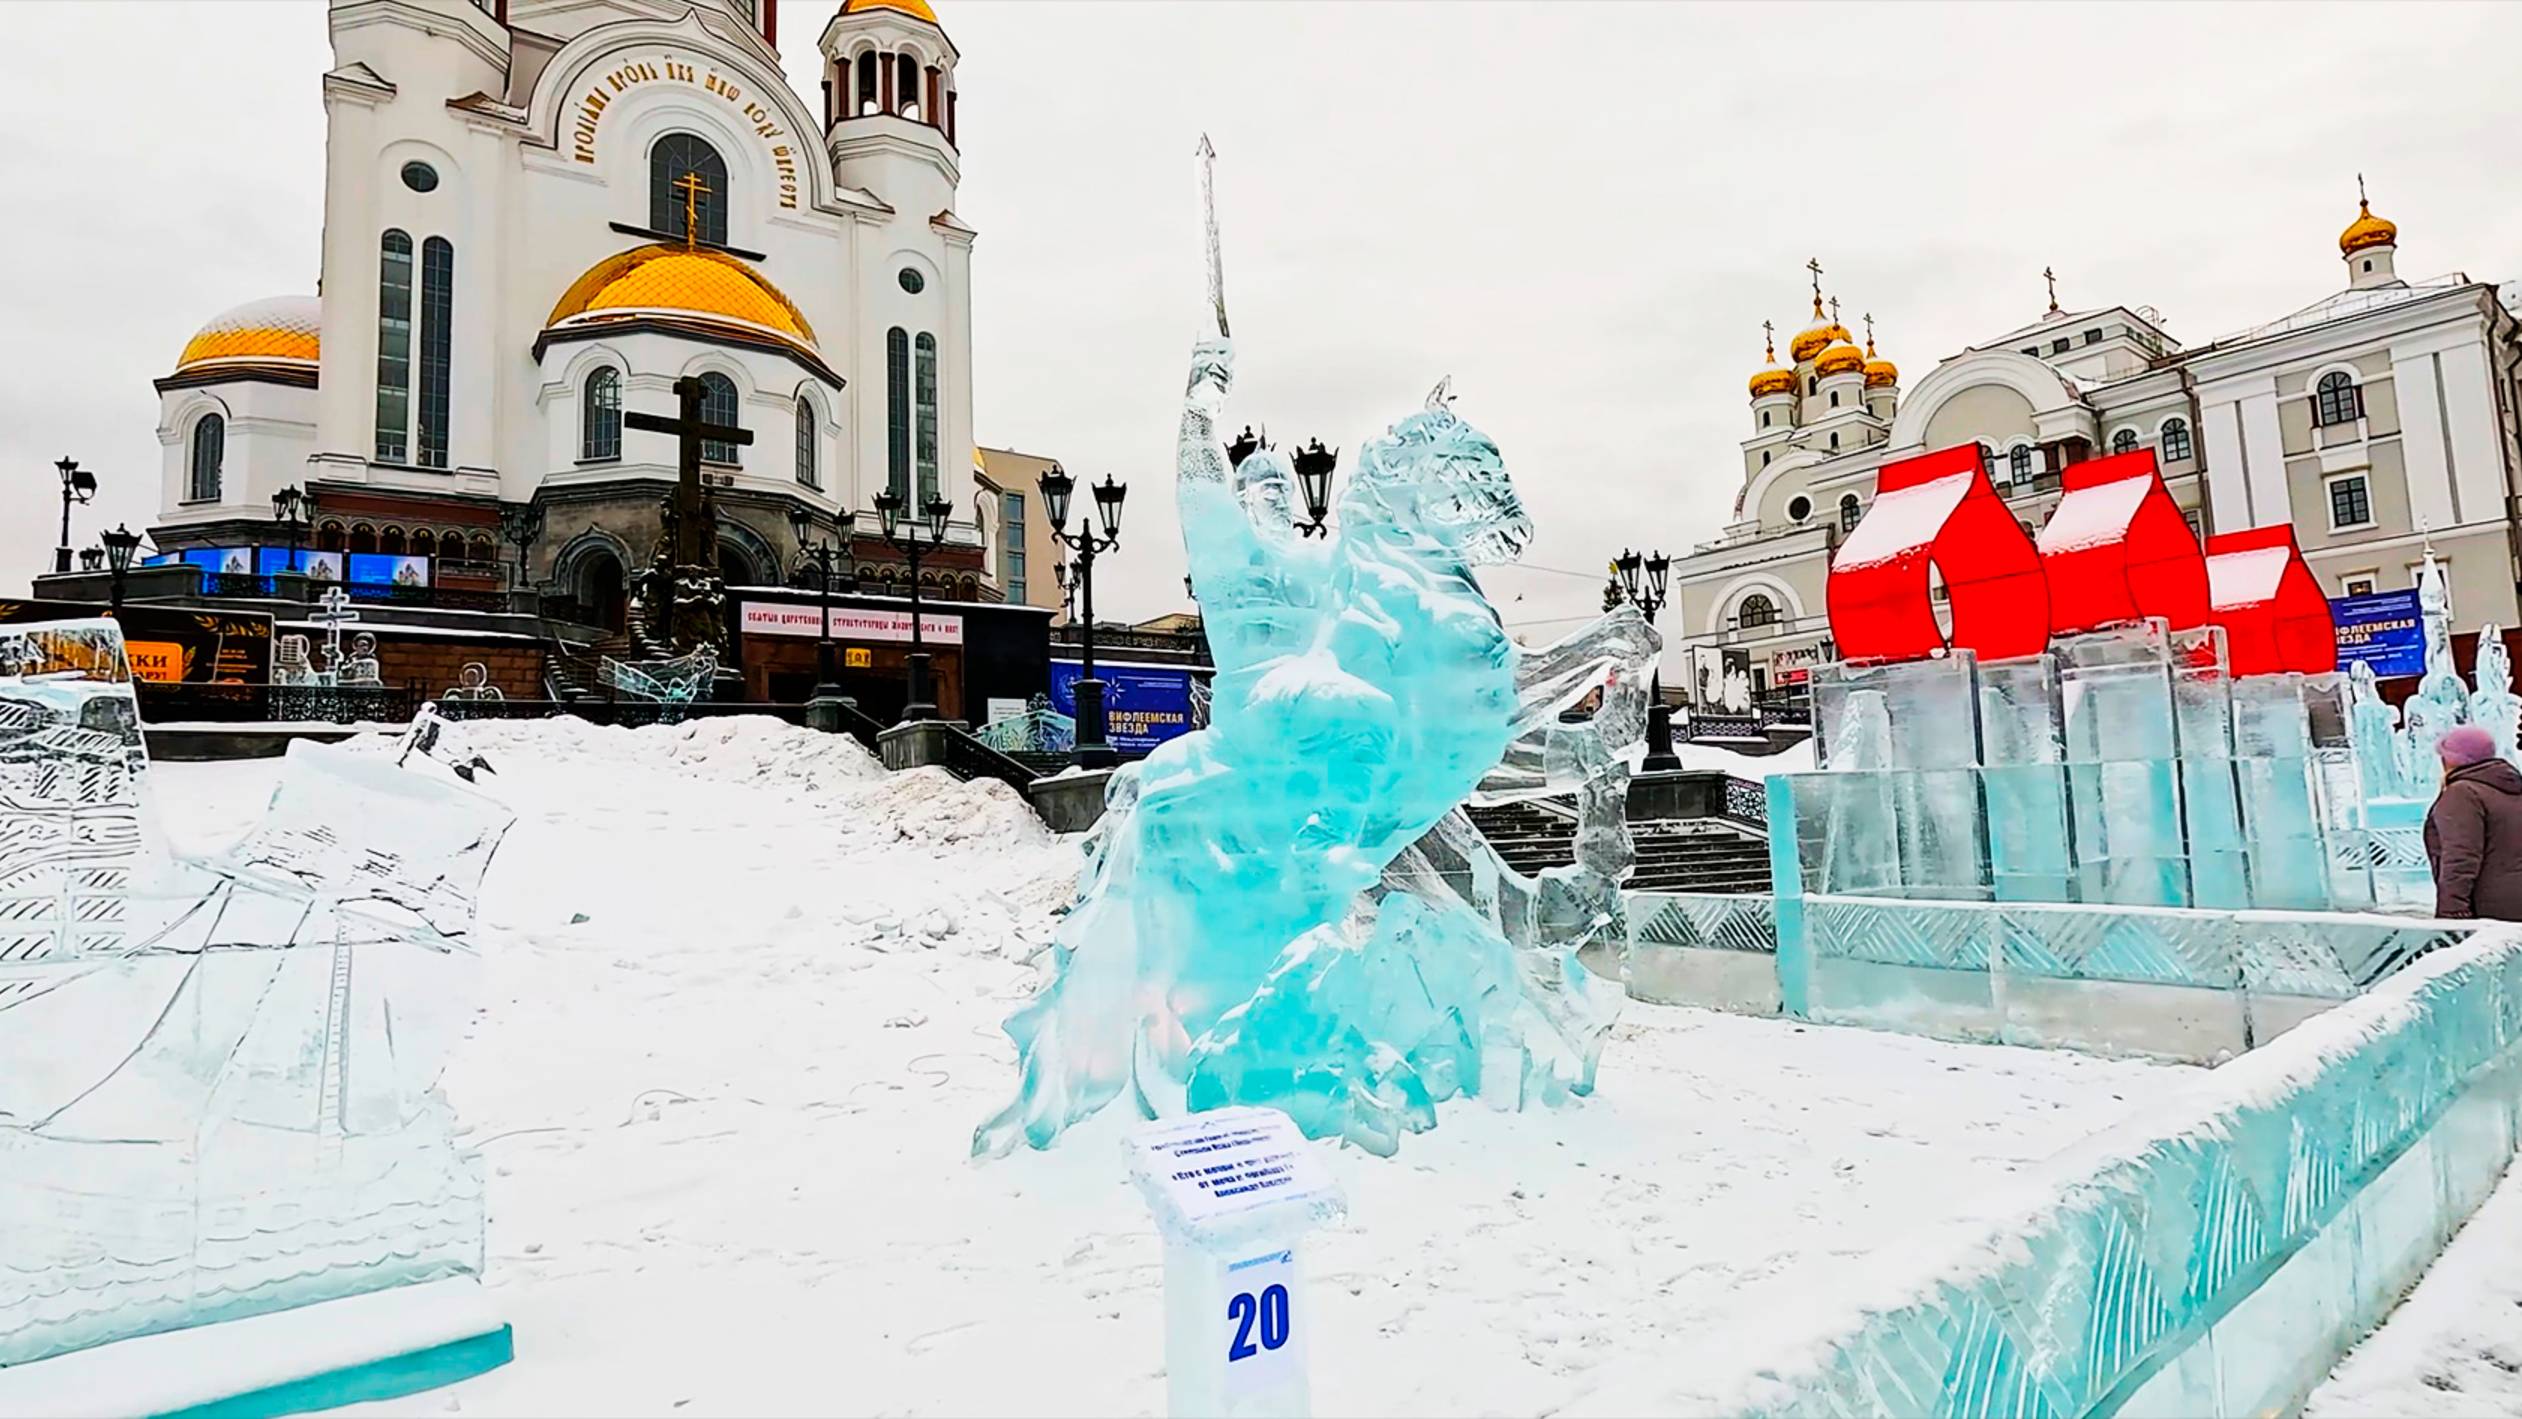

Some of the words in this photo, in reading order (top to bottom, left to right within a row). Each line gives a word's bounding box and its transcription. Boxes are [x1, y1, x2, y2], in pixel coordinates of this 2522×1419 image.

[1108, 711, 1184, 724] ВИФЛЕЕМСКАЯ
[1108, 722, 1149, 735] ЗВЕЗДА
[1228, 1283, 1290, 1362] 20
